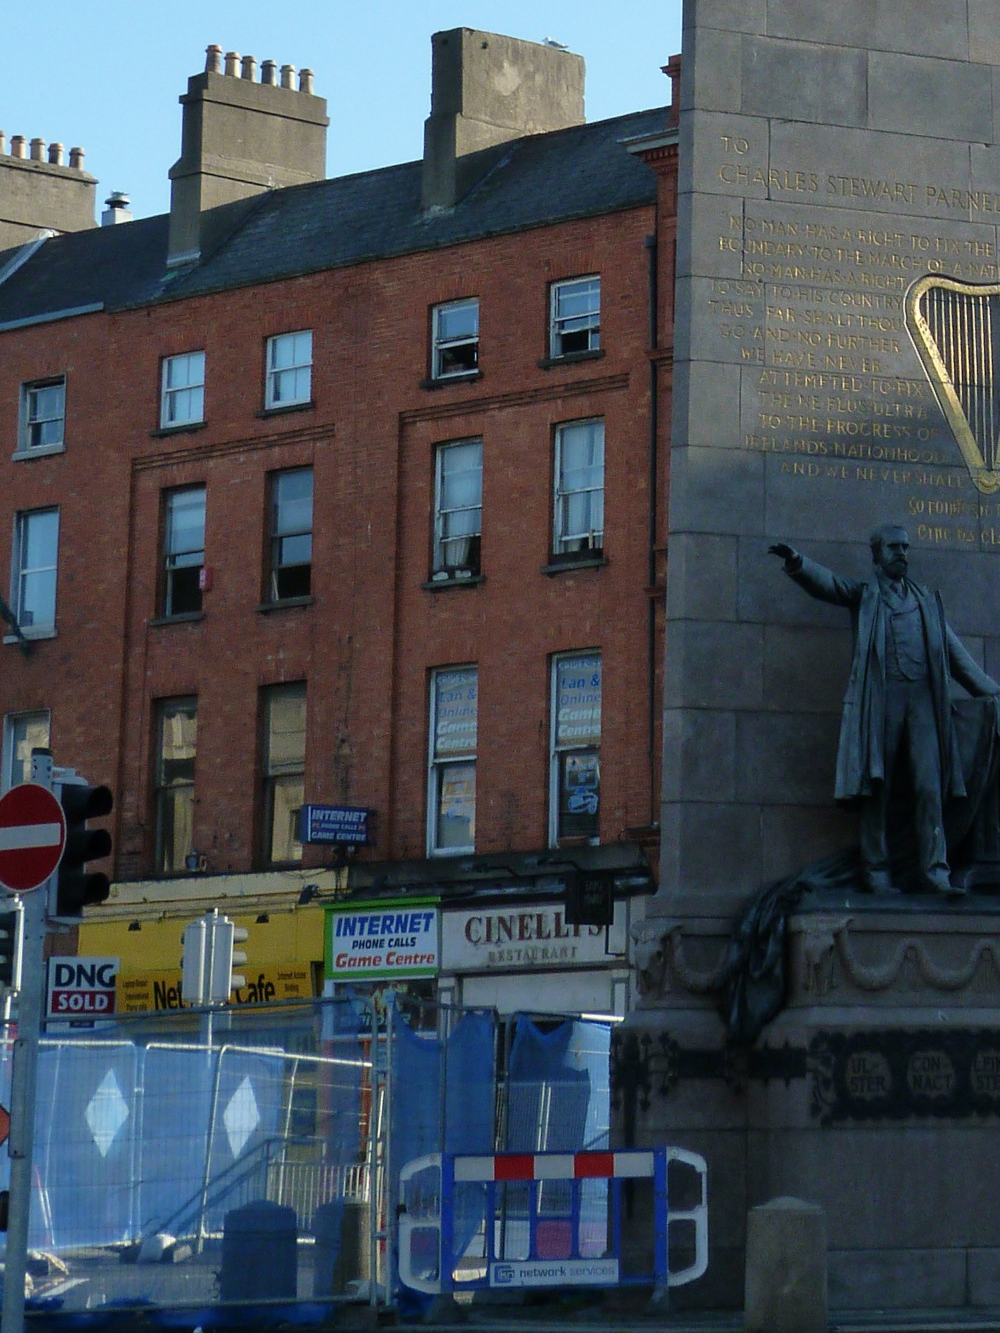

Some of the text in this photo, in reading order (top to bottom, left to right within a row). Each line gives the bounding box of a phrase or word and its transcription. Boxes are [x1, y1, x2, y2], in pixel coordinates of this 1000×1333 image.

[720, 135, 750, 155] TO
[718, 164, 818, 193] CHARLES
[827, 174, 918, 205] STEWART
[761, 218, 799, 236] MAN
[805, 223, 839, 241] HAS
[842, 228, 854, 243] A
[858, 228, 905, 248] RIGHT
[910, 234, 930, 251] TO
[935, 237, 961, 255] FIX
[965, 241, 993, 258] THE
[718, 235, 803, 259] BOUNDARY
[812, 245, 833, 262] TO
[837, 248, 864, 265] THE
[868, 251, 923, 270] MARCH
[927, 258, 947, 273] OF
[952, 262, 963, 276] A
[745, 261, 907, 290] NO MAN HAS A RIGHT
[710, 278, 903, 311] TO SAY TO HIS COUNTRY
[708, 299, 902, 333] THUS FAR SHALT THOU
[719, 323, 901, 355] GO AND NO FURTHER
[739, 346, 881, 373] WE HAVE NEVER
[759, 370, 924, 398] ATTEMPTED TO FIX
[758, 390, 928, 420] THE NE PLUS ULTRA
[758, 412, 939, 442] TO THE PROGRESS OF
[833, 440, 946, 464] NATIONHOOD
[780, 461, 964, 489] AND WE NEVER SHALL
[589, 673, 600, 687] &
[466, 687, 477, 701] &
[312, 809, 367, 823] INTERNET
[311, 831, 367, 842] GAME CENTRE
[335, 912, 435, 937] INTERNET
[352, 936, 417, 950] PHONE CALLS
[488, 946, 578, 964] RESTAURANT
[335, 951, 435, 968] Game Centre
[55, 964, 116, 988] DNG
[58, 993, 109, 1011] SOLD
[153, 980, 186, 1010] Net
[850, 1075, 886, 1092] STER
[912, 1074, 951, 1090] NACT
[519, 1266, 566, 1279] network
[569, 1266, 615, 1277] services
